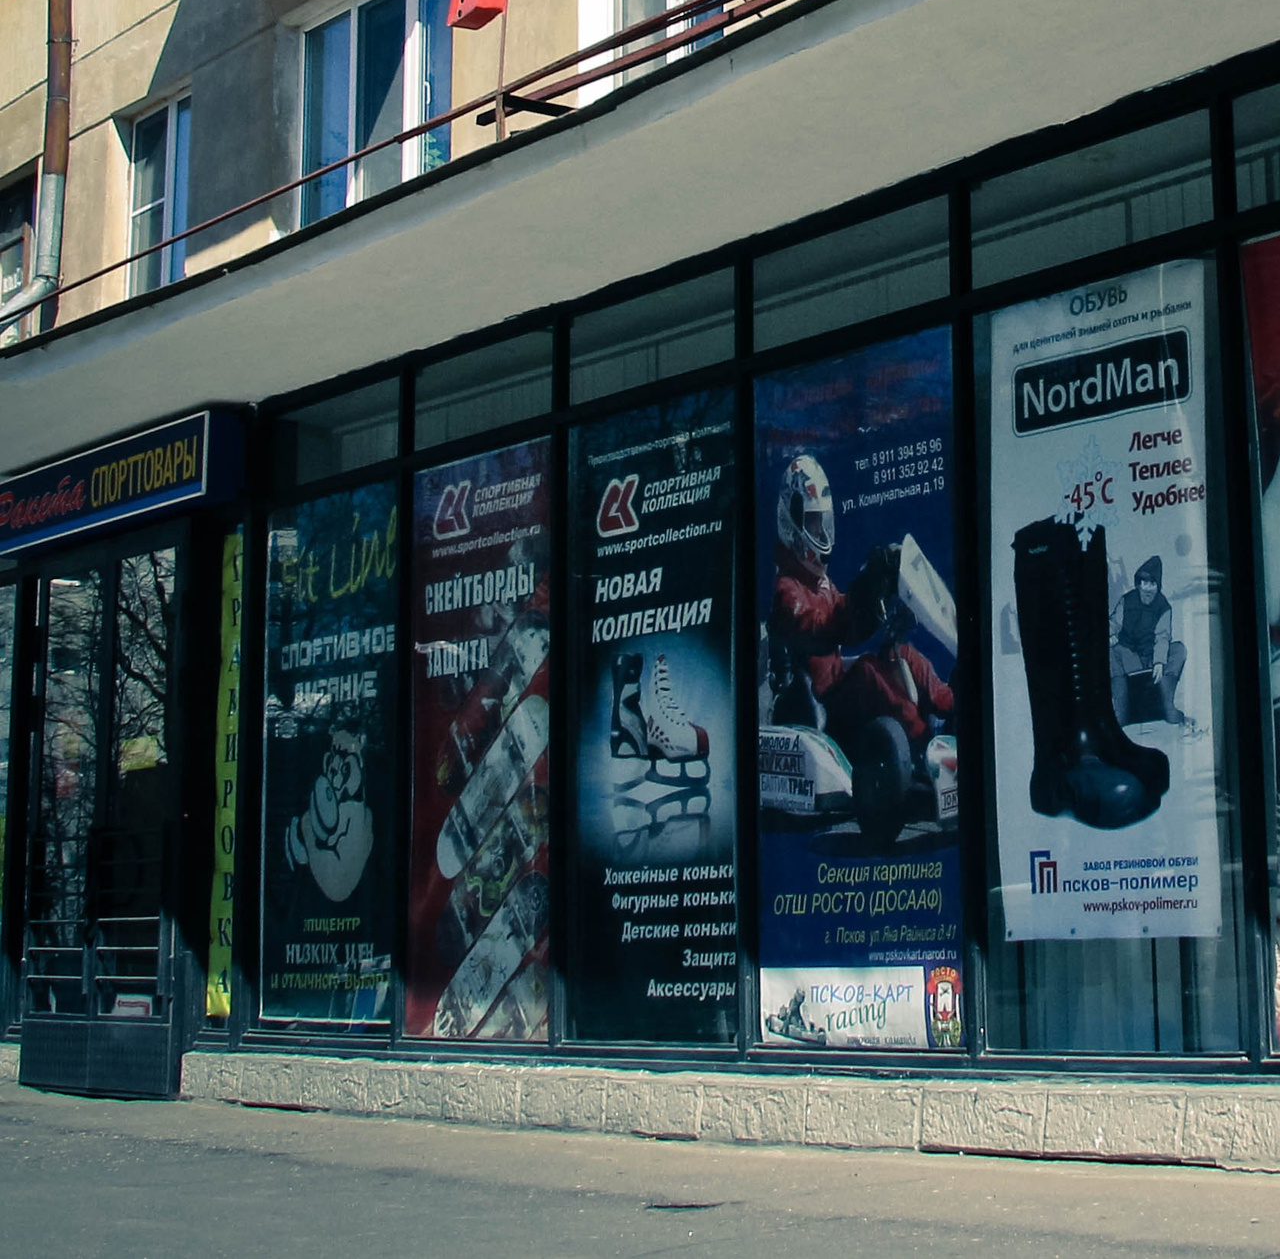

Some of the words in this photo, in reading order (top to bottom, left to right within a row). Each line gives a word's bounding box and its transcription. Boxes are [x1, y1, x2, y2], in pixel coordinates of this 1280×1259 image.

[1070, 285, 1127, 316] ОБУВЬ
[1012, 342, 1029, 355] для
[1030, 327, 1076, 350] ценителей
[1078, 318, 1112, 337] зимней
[1113, 312, 1139, 328] охоты
[1141, 311, 1148, 320] и
[1150, 300, 1192, 322] рыбалки
[1022, 357, 1179, 419] NordMan
[872, 453, 877, 466] 8
[879, 449, 894, 464] 911
[897, 445, 914, 460] 394
[916, 441, 927, 456] 56
[929, 437, 942, 453] 96
[1129, 429, 1182, 452] Легче
[90, 434, 198, 508] СПОРТТОВАРЫ
[644, 466, 721, 498] СПОРТИВНАЯ
[874, 471, 880, 485] 8
[881, 468, 896, 483] 911
[898, 463, 915, 479] 352
[917, 460, 929, 475] 92
[931, 456, 944, 471] 42
[1129, 457, 1192, 482] Теплее
[475, 473, 542, 503] СПОРТИВНАЯ
[641, 484, 711, 514] КОЛЛЕКЦИЯ
[859, 483, 921, 506] Коммунальная
[1132, 483, 1205, 515] Удобнее
[472, 490, 534, 517] КОЛЛЕКЦИЯ
[431, 524, 541, 559] www.sportcollection.ru
[596, 519, 722, 558] www.sportcollection.ru
[425, 562, 536, 615] СКЕЙТБОРДЫ
[594, 567, 663, 604] НОВАЯ
[592, 597, 713, 644] КОЛЛЕКЦИЯ
[281, 624, 395, 671] СПОРТИВНОЕ
[425, 638, 490, 679] ЗАЩИТА
[216, 553, 244, 994] ГРАВИРОВКА
[603, 866, 679, 886] Хоккейные
[682, 864, 734, 881] коньки
[817, 863, 870, 886] Секция
[873, 861, 942, 885] картинга
[1083, 860, 1112, 872] ЗАВОД
[1113, 856, 1165, 870] РЕЗИНОВОЙ
[1168, 857, 1199, 868] ОБУВИ
[1063, 874, 1199, 892] псков-полимер
[611, 892, 679, 914] Фигурные
[683, 890, 736, 907] коньки
[774, 895, 806, 915] ОТШ
[811, 891, 865, 914] РОСТО
[869, 888, 942, 917] (ДОСААФ)
[1083, 896, 1198, 915] www.pskov-polimer.ru
[621, 921, 680, 942] Детские
[684, 922, 738, 937] коньки
[836, 927, 865, 944] Псков
[882, 926, 897, 942] Яна
[900, 925, 936, 942] Райниса
[286, 943, 338, 964] НИЗКИХ
[345, 943, 374, 970] ЦЕН
[682, 948, 737, 969] Защита
[271, 972, 279, 989] И
[281, 972, 340, 990] ОТЛИЧНОГО
[647, 978, 737, 1001] Аксессуары
[810, 985, 913, 1004] ПСКОВ-КАРТ
[825, 1000, 886, 1032] racing
